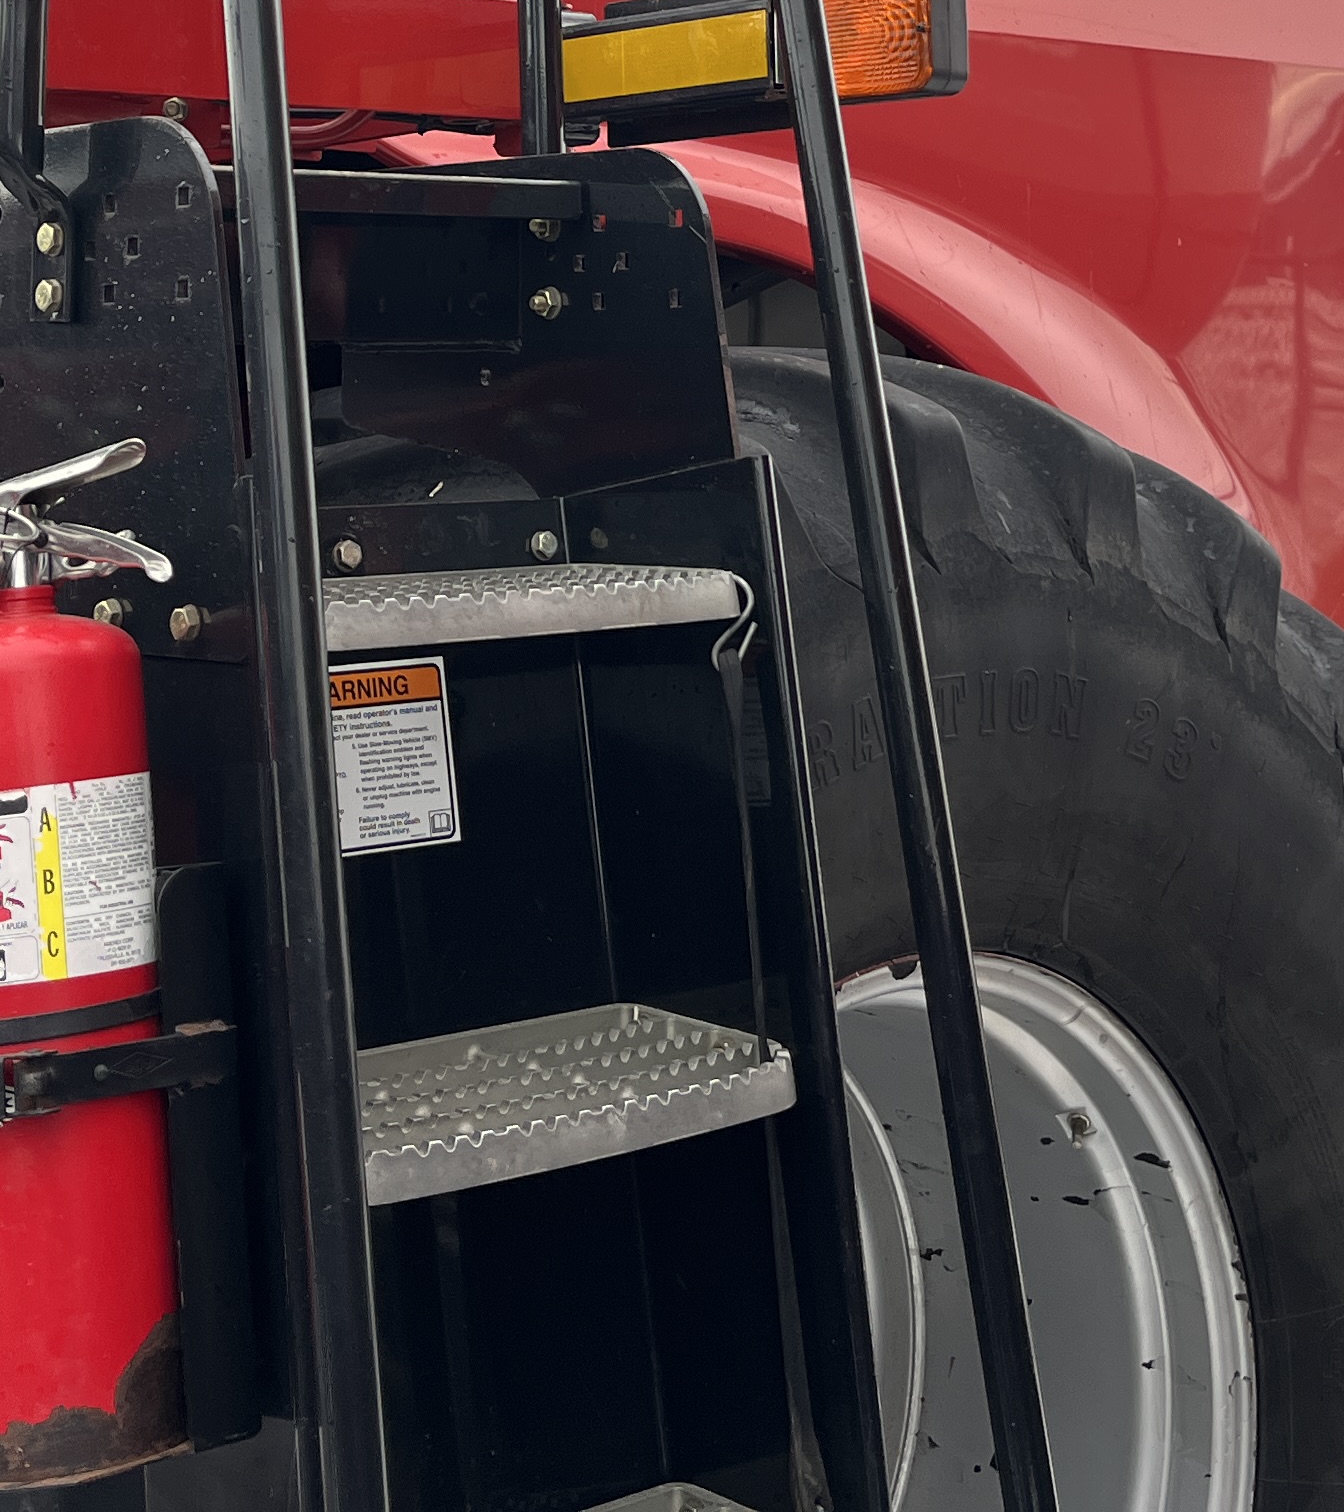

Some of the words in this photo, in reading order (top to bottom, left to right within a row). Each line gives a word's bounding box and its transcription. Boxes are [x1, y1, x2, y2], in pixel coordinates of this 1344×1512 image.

[329, 675, 409, 702] ARNING
[363, 709, 397, 718] operator's
[400, 706, 423, 714] manual
[350, 721, 392, 730] instructions.
[808, 667, 1089, 791] RATION
[39, 807, 52, 833] A
[43, 869, 55, 895] B
[47, 931, 60, 958] C
